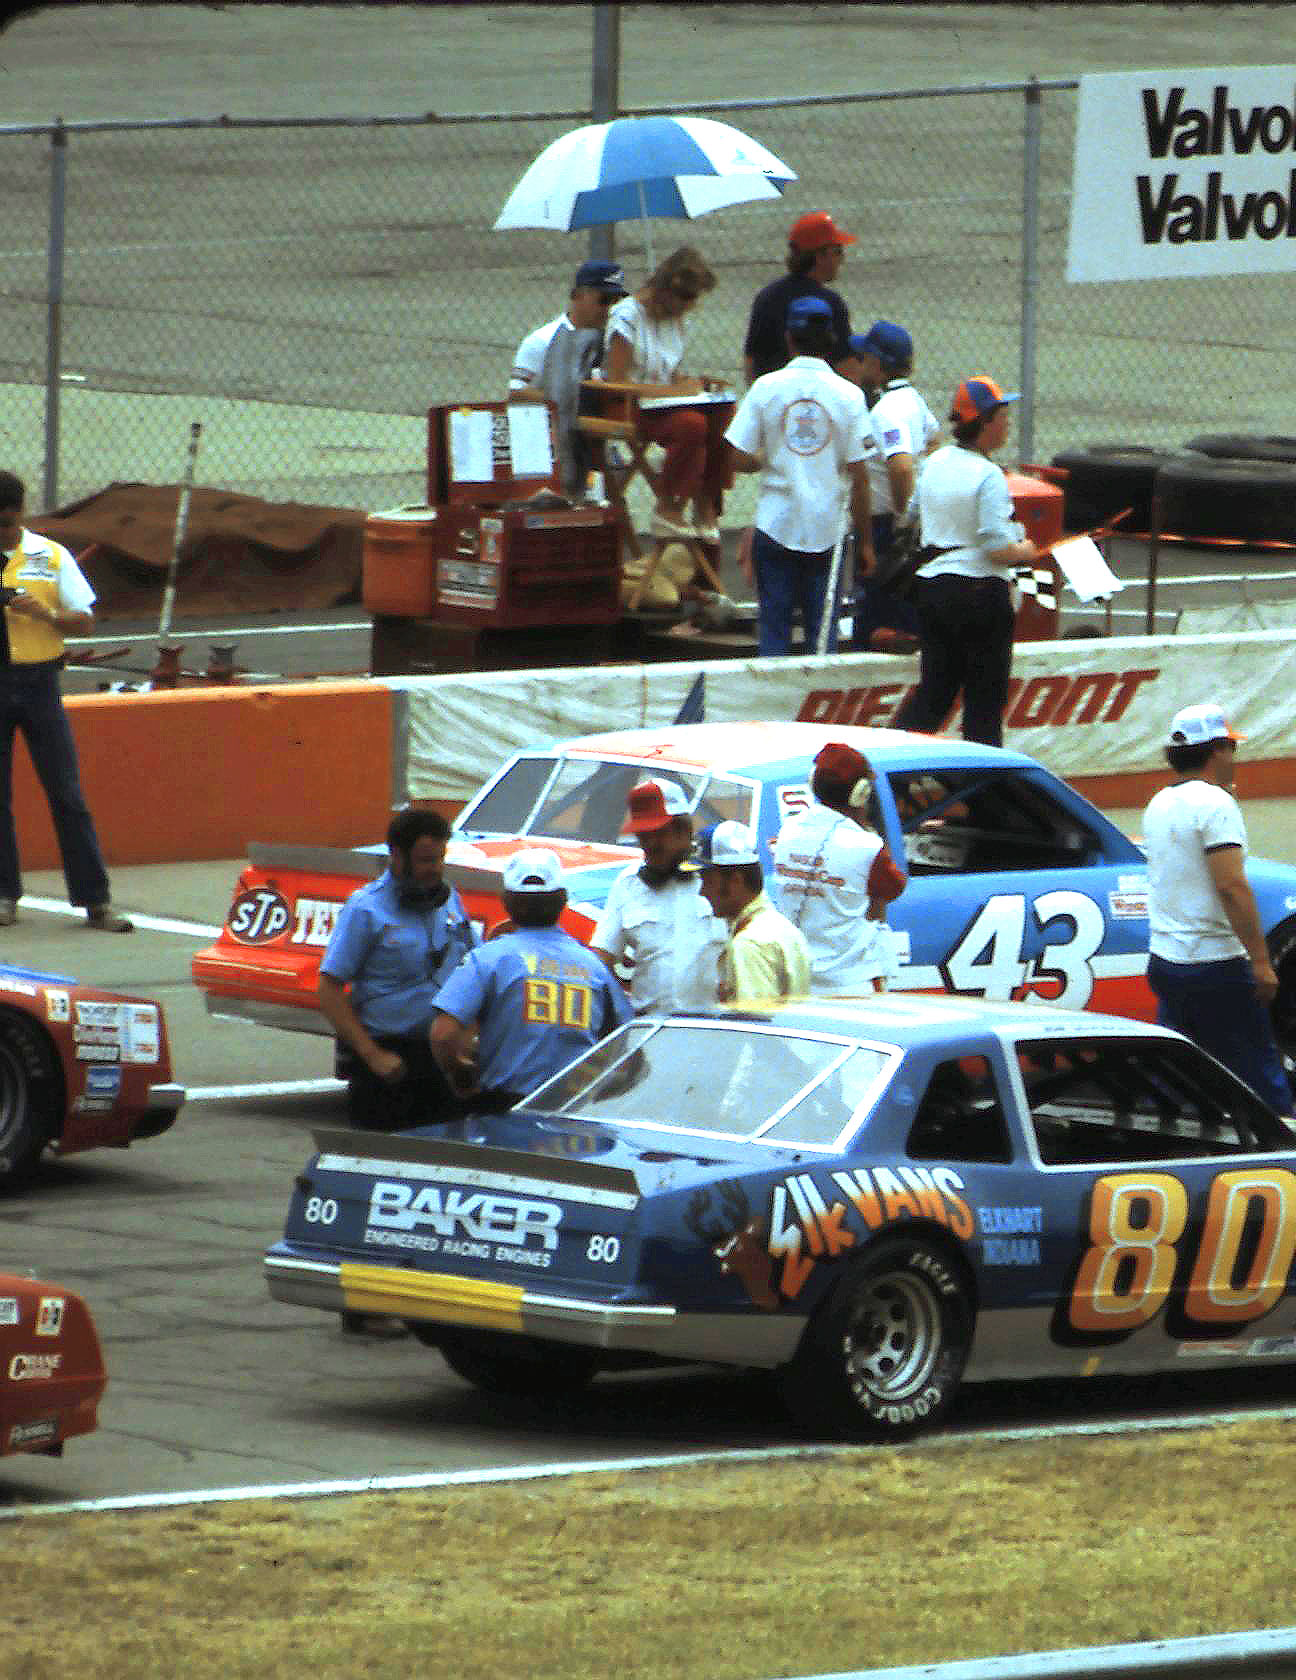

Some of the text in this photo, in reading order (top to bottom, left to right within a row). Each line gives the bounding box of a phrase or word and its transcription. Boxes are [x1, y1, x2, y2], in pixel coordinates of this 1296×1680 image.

[230, 893, 290, 940] STP
[944, 889, 1106, 1011] 43
[522, 978, 593, 1030] 80
[303, 1197, 338, 1225] 80
[367, 1181, 563, 1250] BAKER
[831, 1166, 976, 1242] VANS
[364, 1229, 552, 1268] ENGINEERED RACING ENGINES
[586, 1233, 621, 1264] 80
